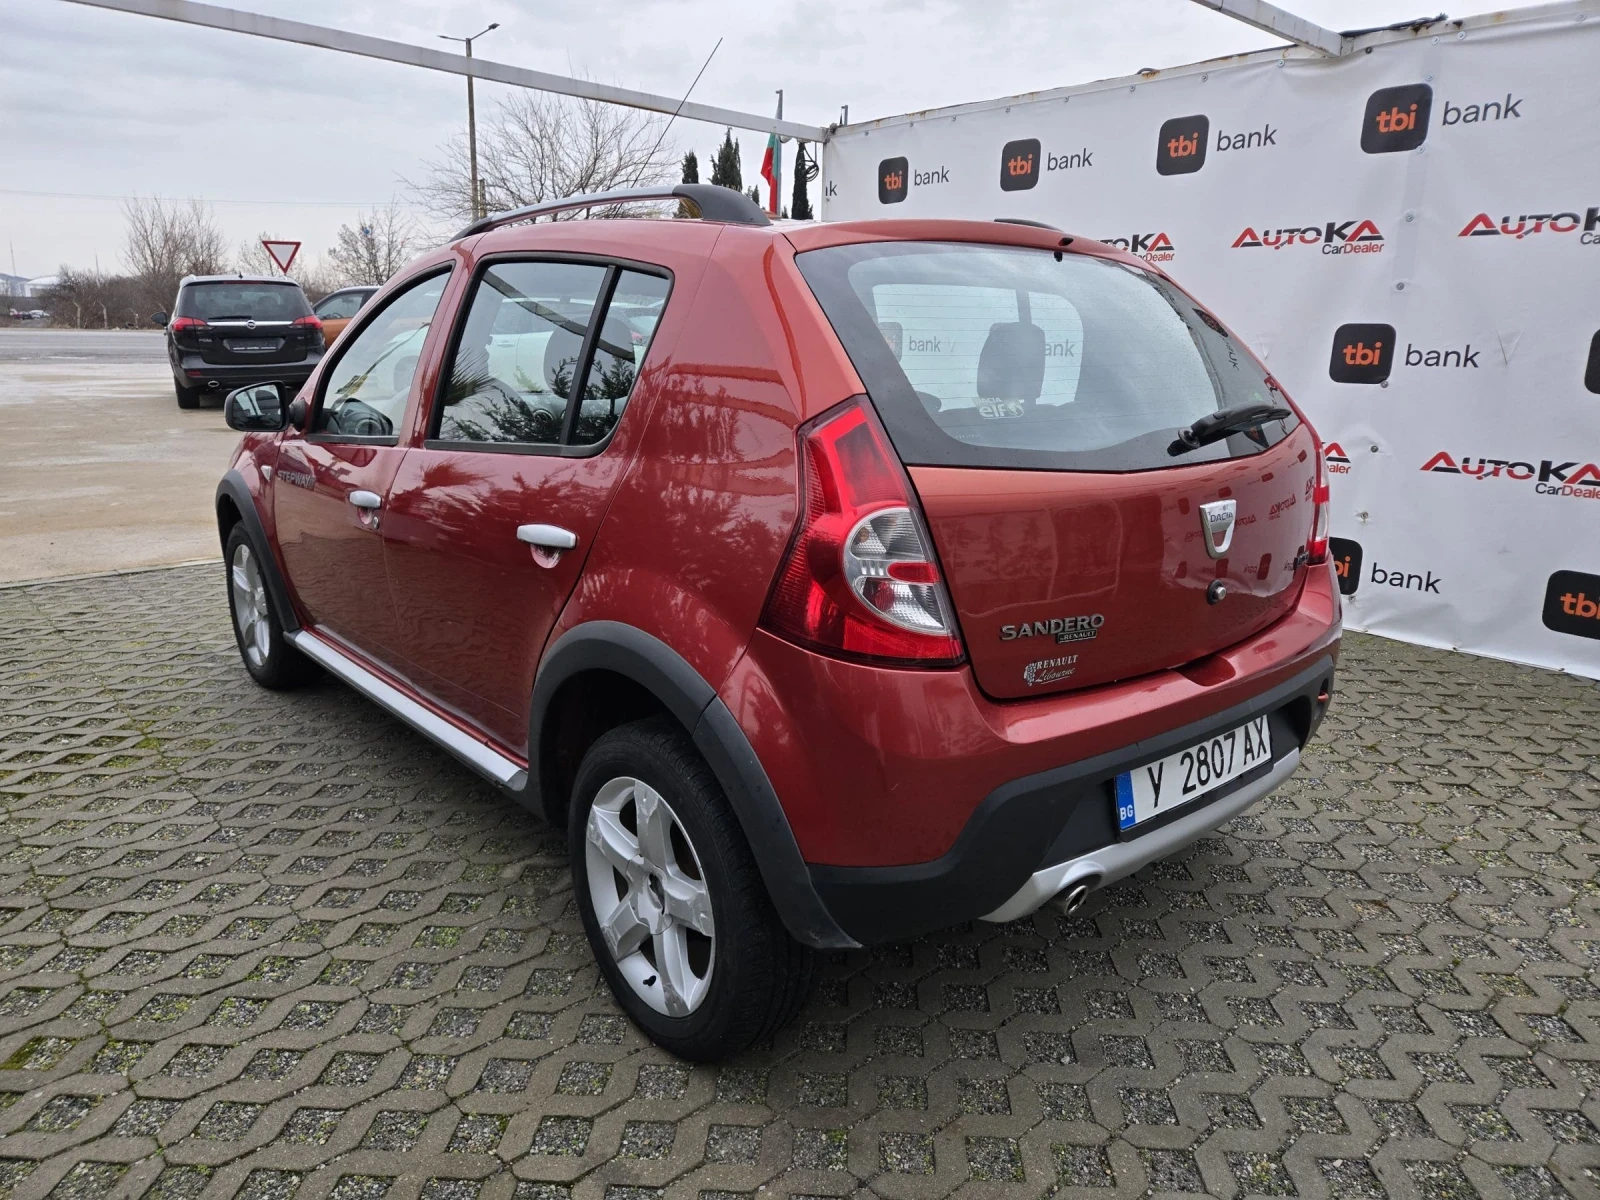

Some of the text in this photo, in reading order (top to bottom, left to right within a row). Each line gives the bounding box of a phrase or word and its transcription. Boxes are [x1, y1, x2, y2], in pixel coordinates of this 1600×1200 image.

[1376, 94, 1523, 133] tbi bank
[1168, 124, 1277, 157] tbi bank
[1008, 148, 1093, 176] tbi bank
[884, 166, 950, 190] tbi bank
[1322, 242, 1384, 254] CarDealer
[909, 336, 941, 353] bank
[1044, 339, 1075, 358] ank
[1343, 342, 1481, 368] tbi bank
[979, 404, 1006, 418] elf
[277, 470, 312, 489] STEPWAY
[1535, 483, 1600, 500] CarDeale
[1210, 512, 1234, 523] DACIA
[1371, 563, 1442, 594] bank
[1001, 613, 1105, 640] SANDERO
[1064, 631, 1096, 640] RENAULT
[1037, 654, 1079, 670] RENAULT
[1179, 730, 1236, 795] 2807
[1243, 717, 1267, 766] AX
[1119, 805, 1134, 821] BG
